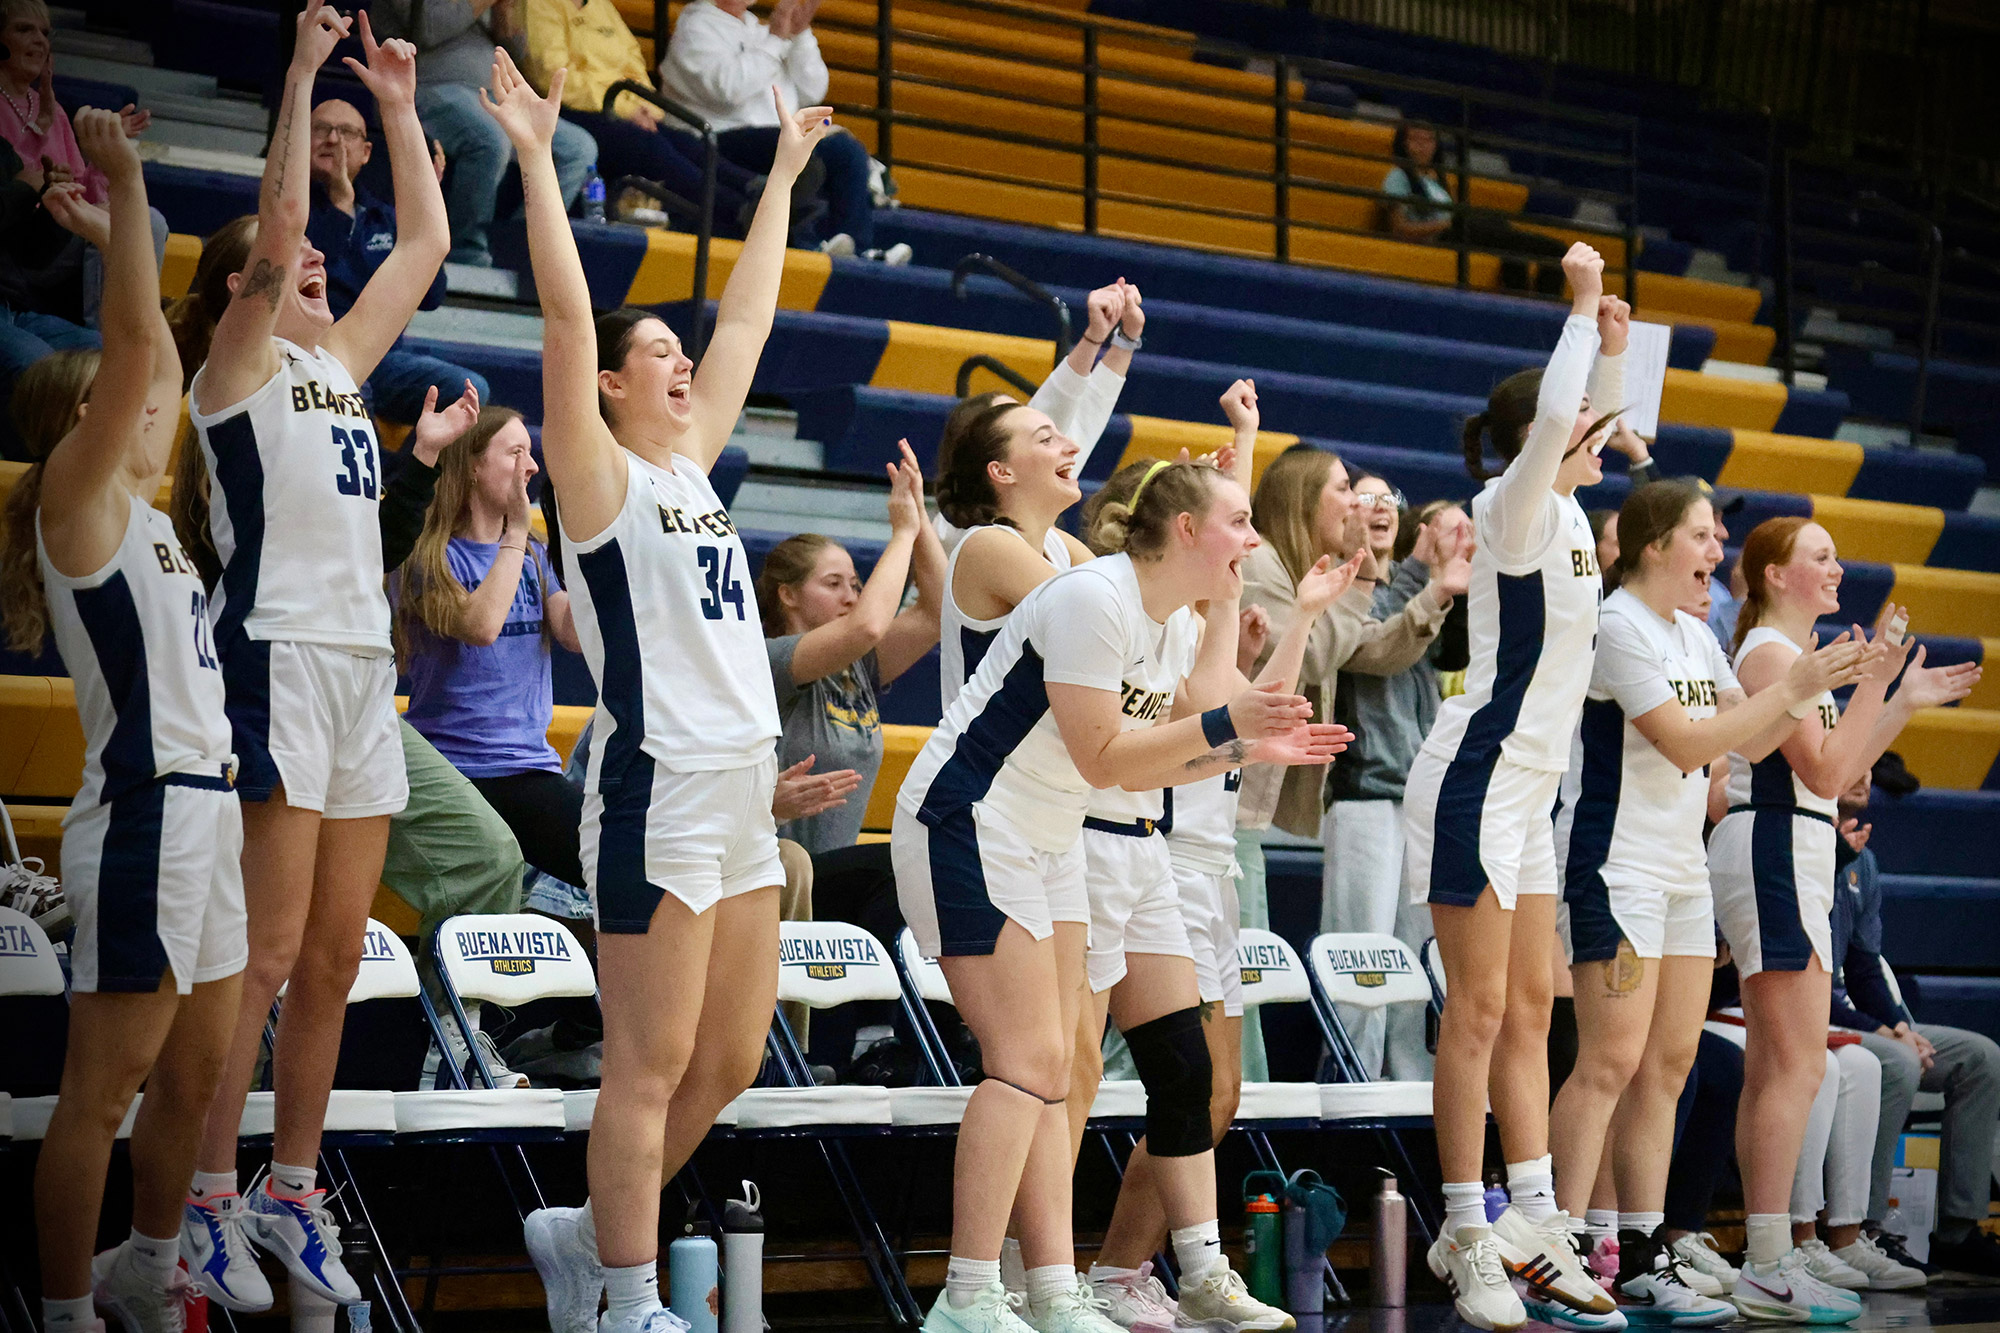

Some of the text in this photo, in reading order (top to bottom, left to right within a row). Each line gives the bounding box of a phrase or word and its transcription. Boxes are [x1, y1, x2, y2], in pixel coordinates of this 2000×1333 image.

[331, 424, 377, 501] 33
[697, 546, 746, 621] 34
[455, 932, 571, 957] BUENA VISTA
[826, 939, 880, 962] VISTA
[494, 960, 533, 973] ATHLETICS
[1243, 945, 1291, 967] VISTA
[1327, 949, 1412, 971] BUENA VISTA
[809, 965, 845, 978] ATHLETICS
[1356, 973, 1385, 985] ATHLETICS
